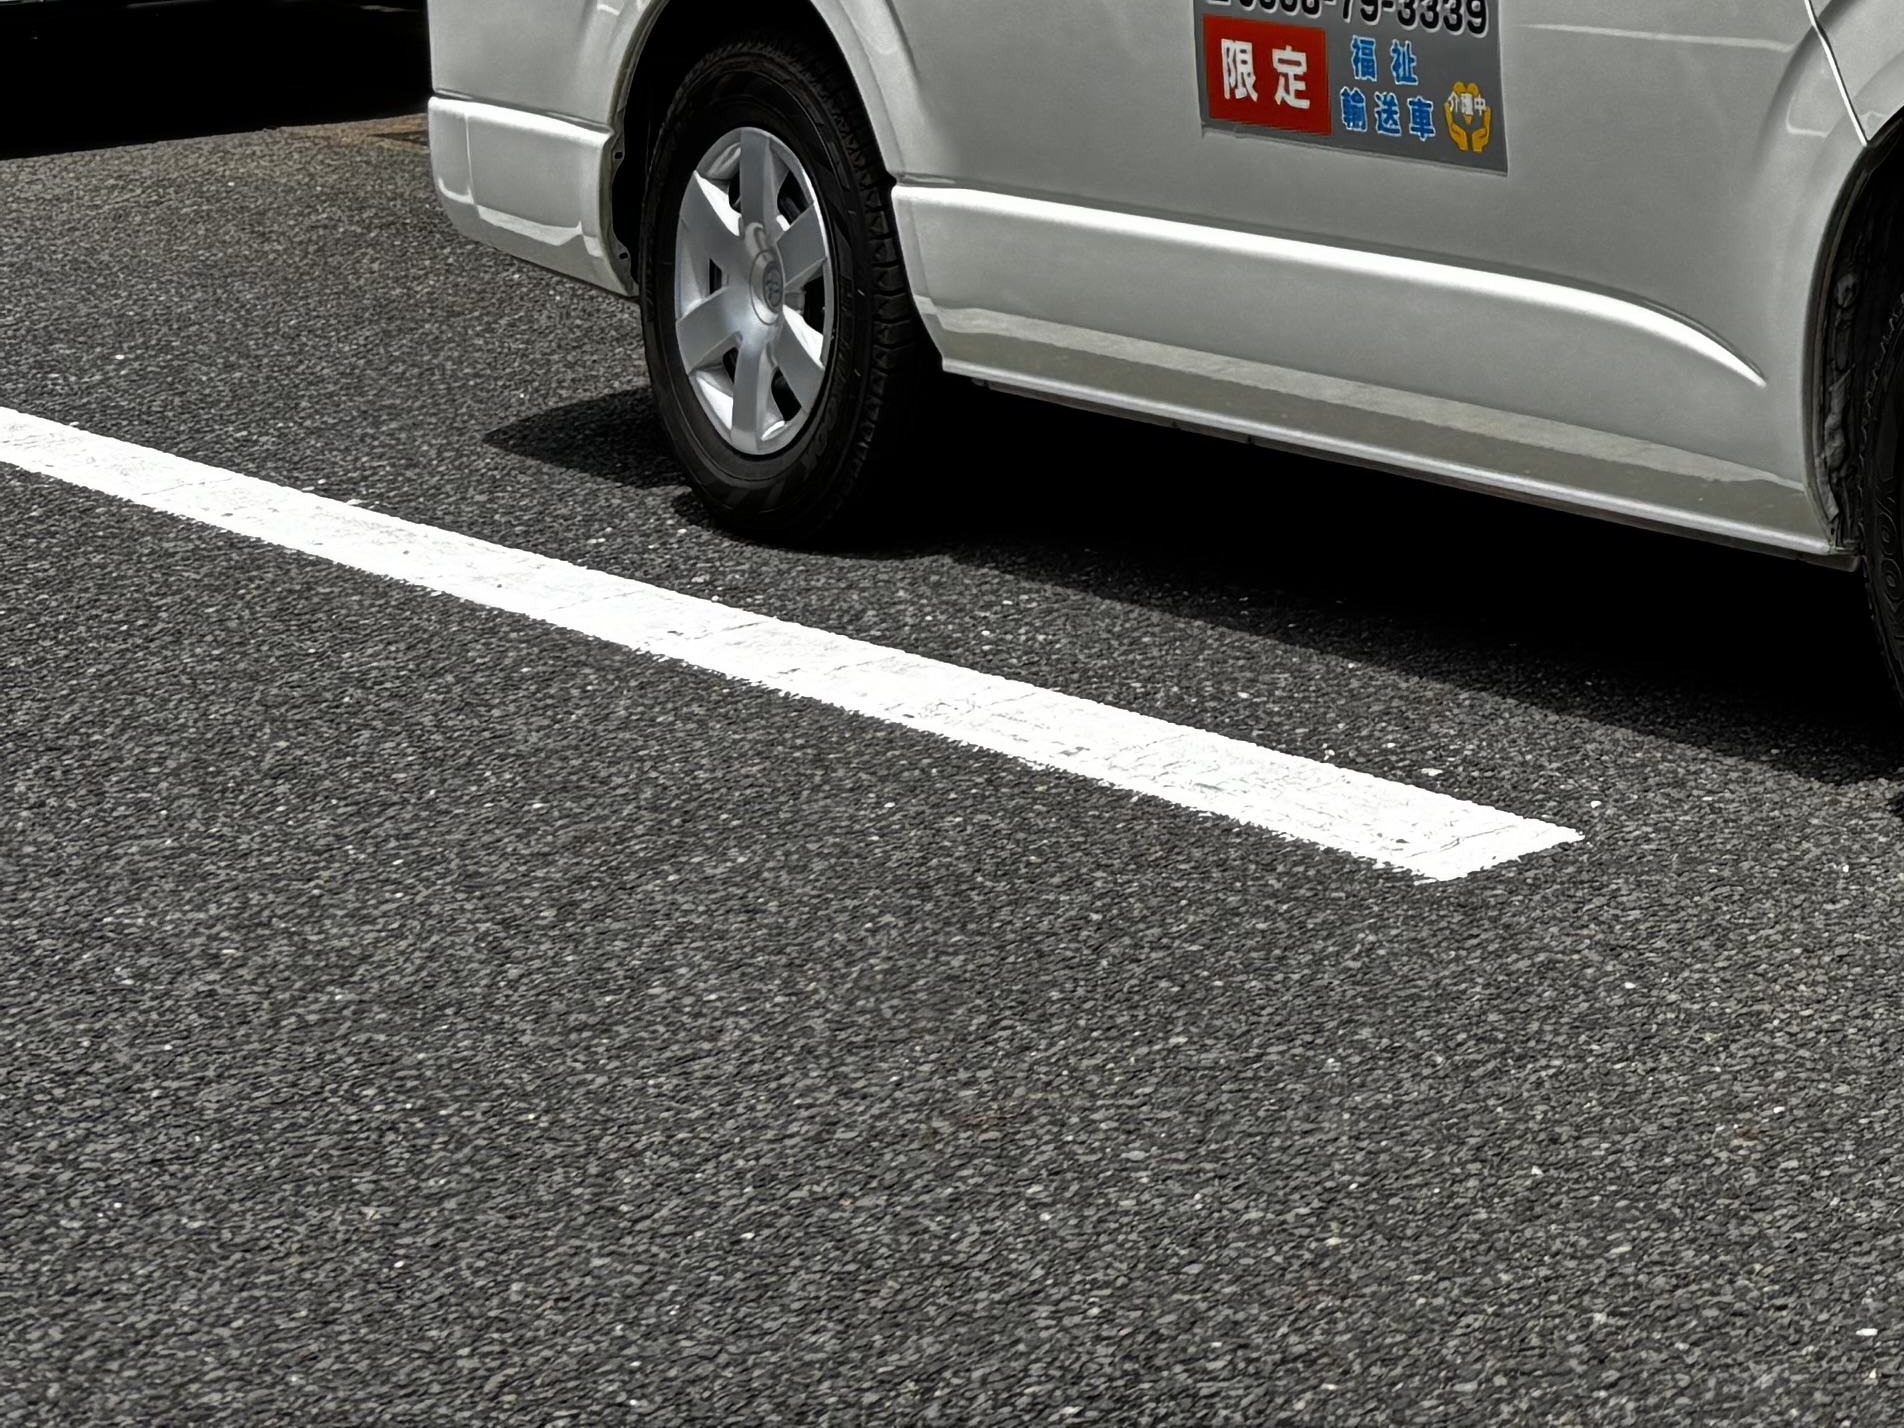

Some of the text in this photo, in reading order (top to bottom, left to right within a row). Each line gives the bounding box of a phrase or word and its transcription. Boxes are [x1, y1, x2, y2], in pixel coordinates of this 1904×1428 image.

[1221, 38, 1310, 110] 限定
[1351, 35, 1418, 85] 福祉
[1340, 86, 1436, 141] 輸送車
